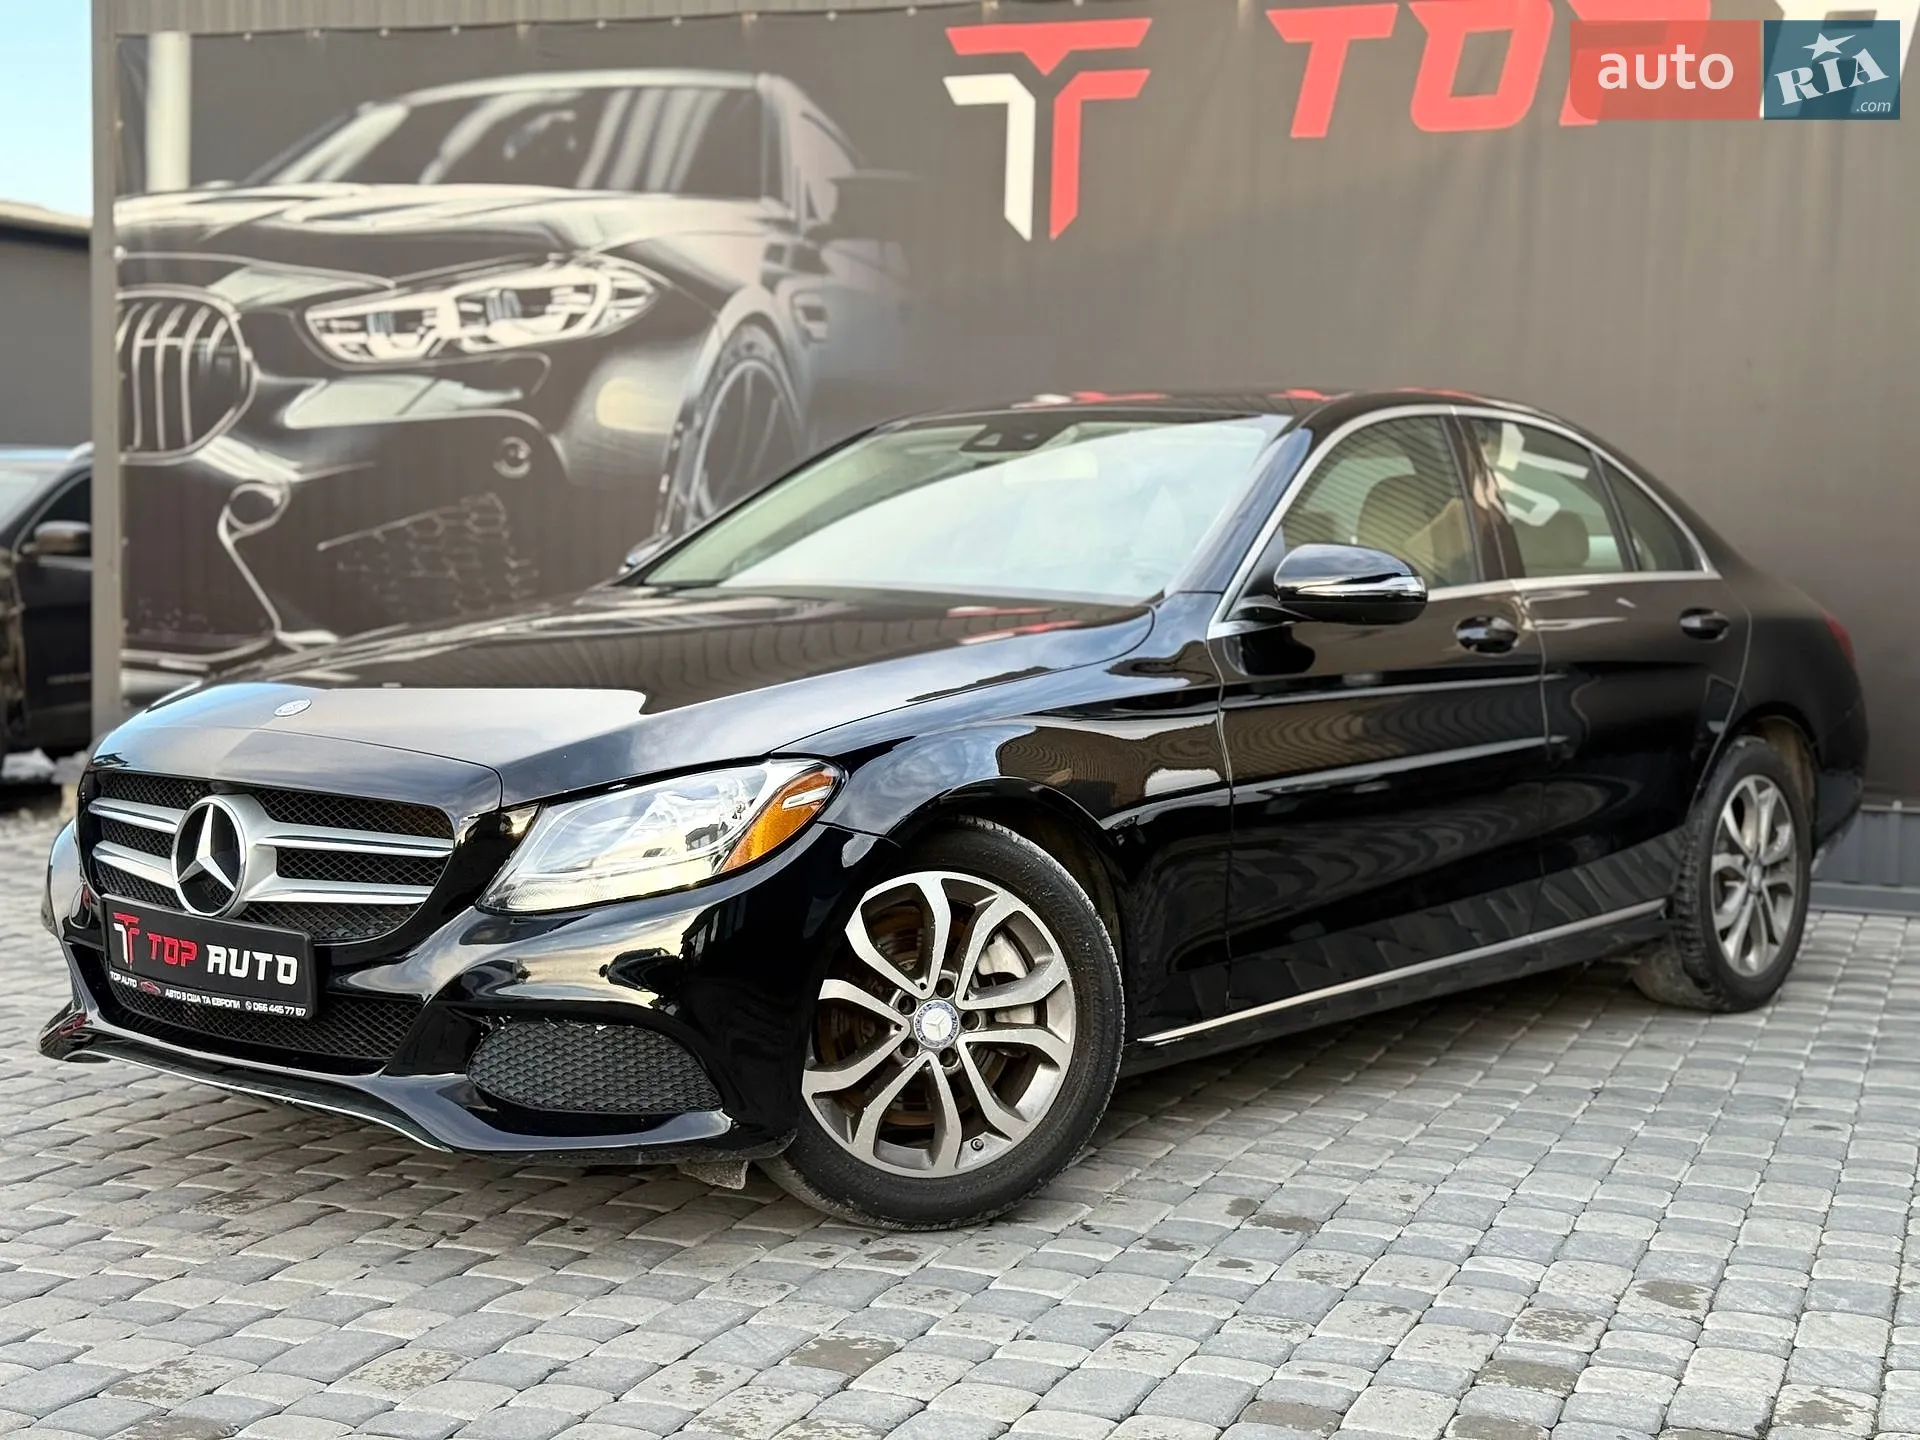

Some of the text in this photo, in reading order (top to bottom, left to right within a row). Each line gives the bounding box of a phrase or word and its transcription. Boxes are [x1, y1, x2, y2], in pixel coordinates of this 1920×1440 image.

[147, 932, 299, 986] TOP AUTO
[109, 970, 138, 988] TOP AUTO
[284, 1006, 295, 1016] 77
